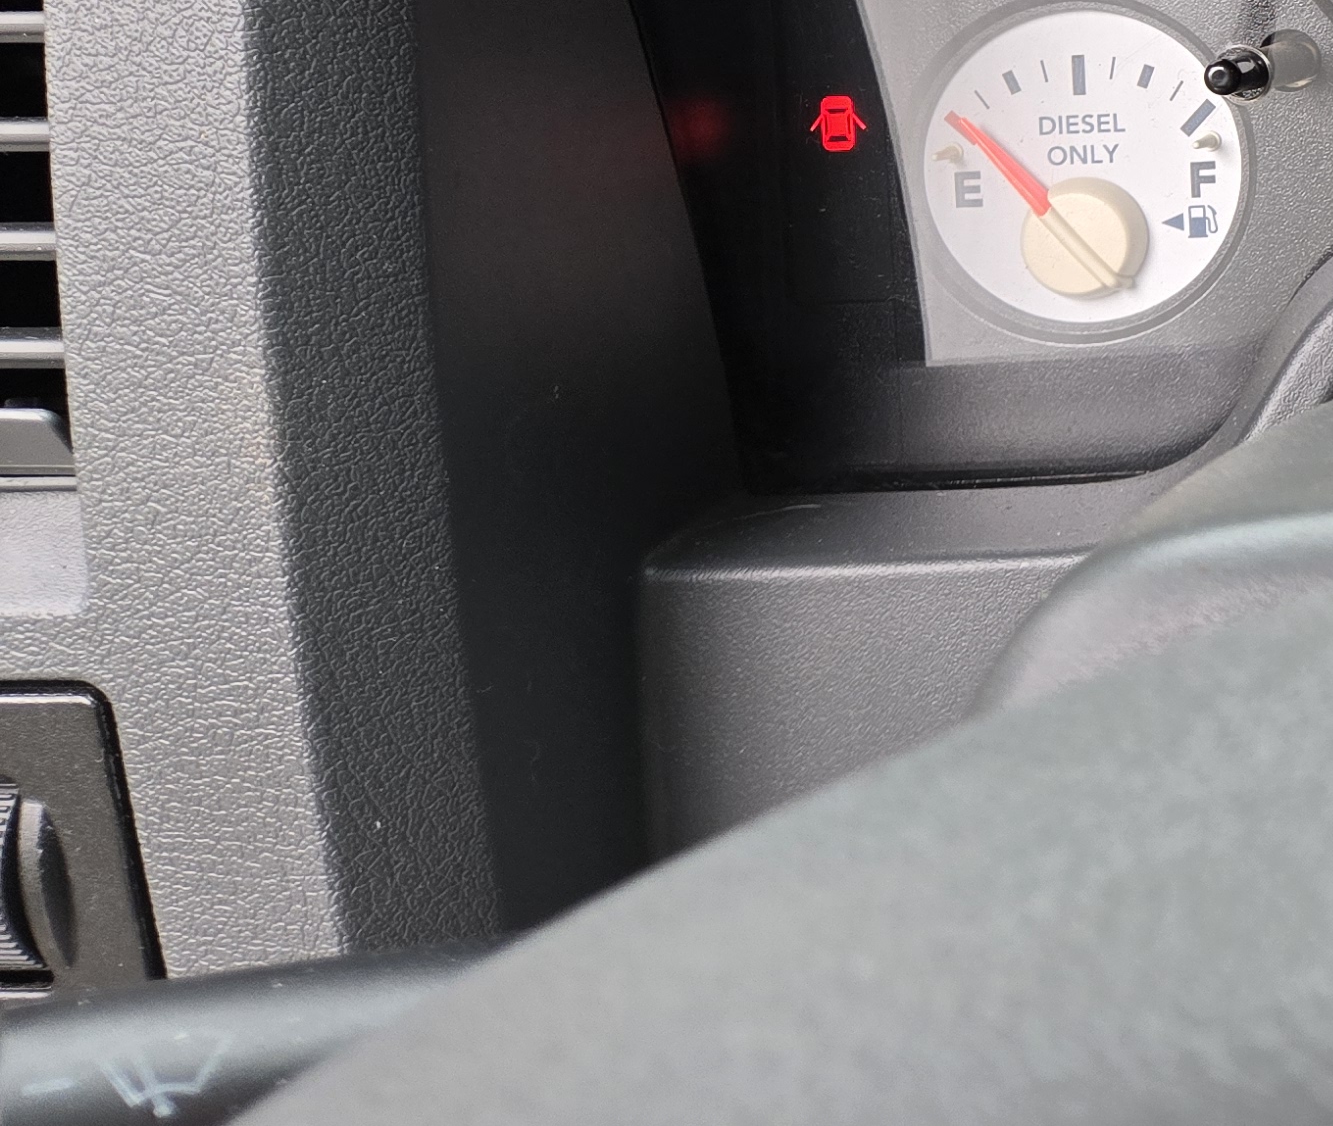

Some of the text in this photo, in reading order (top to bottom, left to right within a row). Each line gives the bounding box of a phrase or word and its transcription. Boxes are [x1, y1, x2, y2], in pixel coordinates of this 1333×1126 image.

[1038, 112, 1126, 136] DIESEL
[1047, 143, 1120, 166] ONLY
[953, 170, 984, 209] E
[1189, 160, 1217, 199] F
